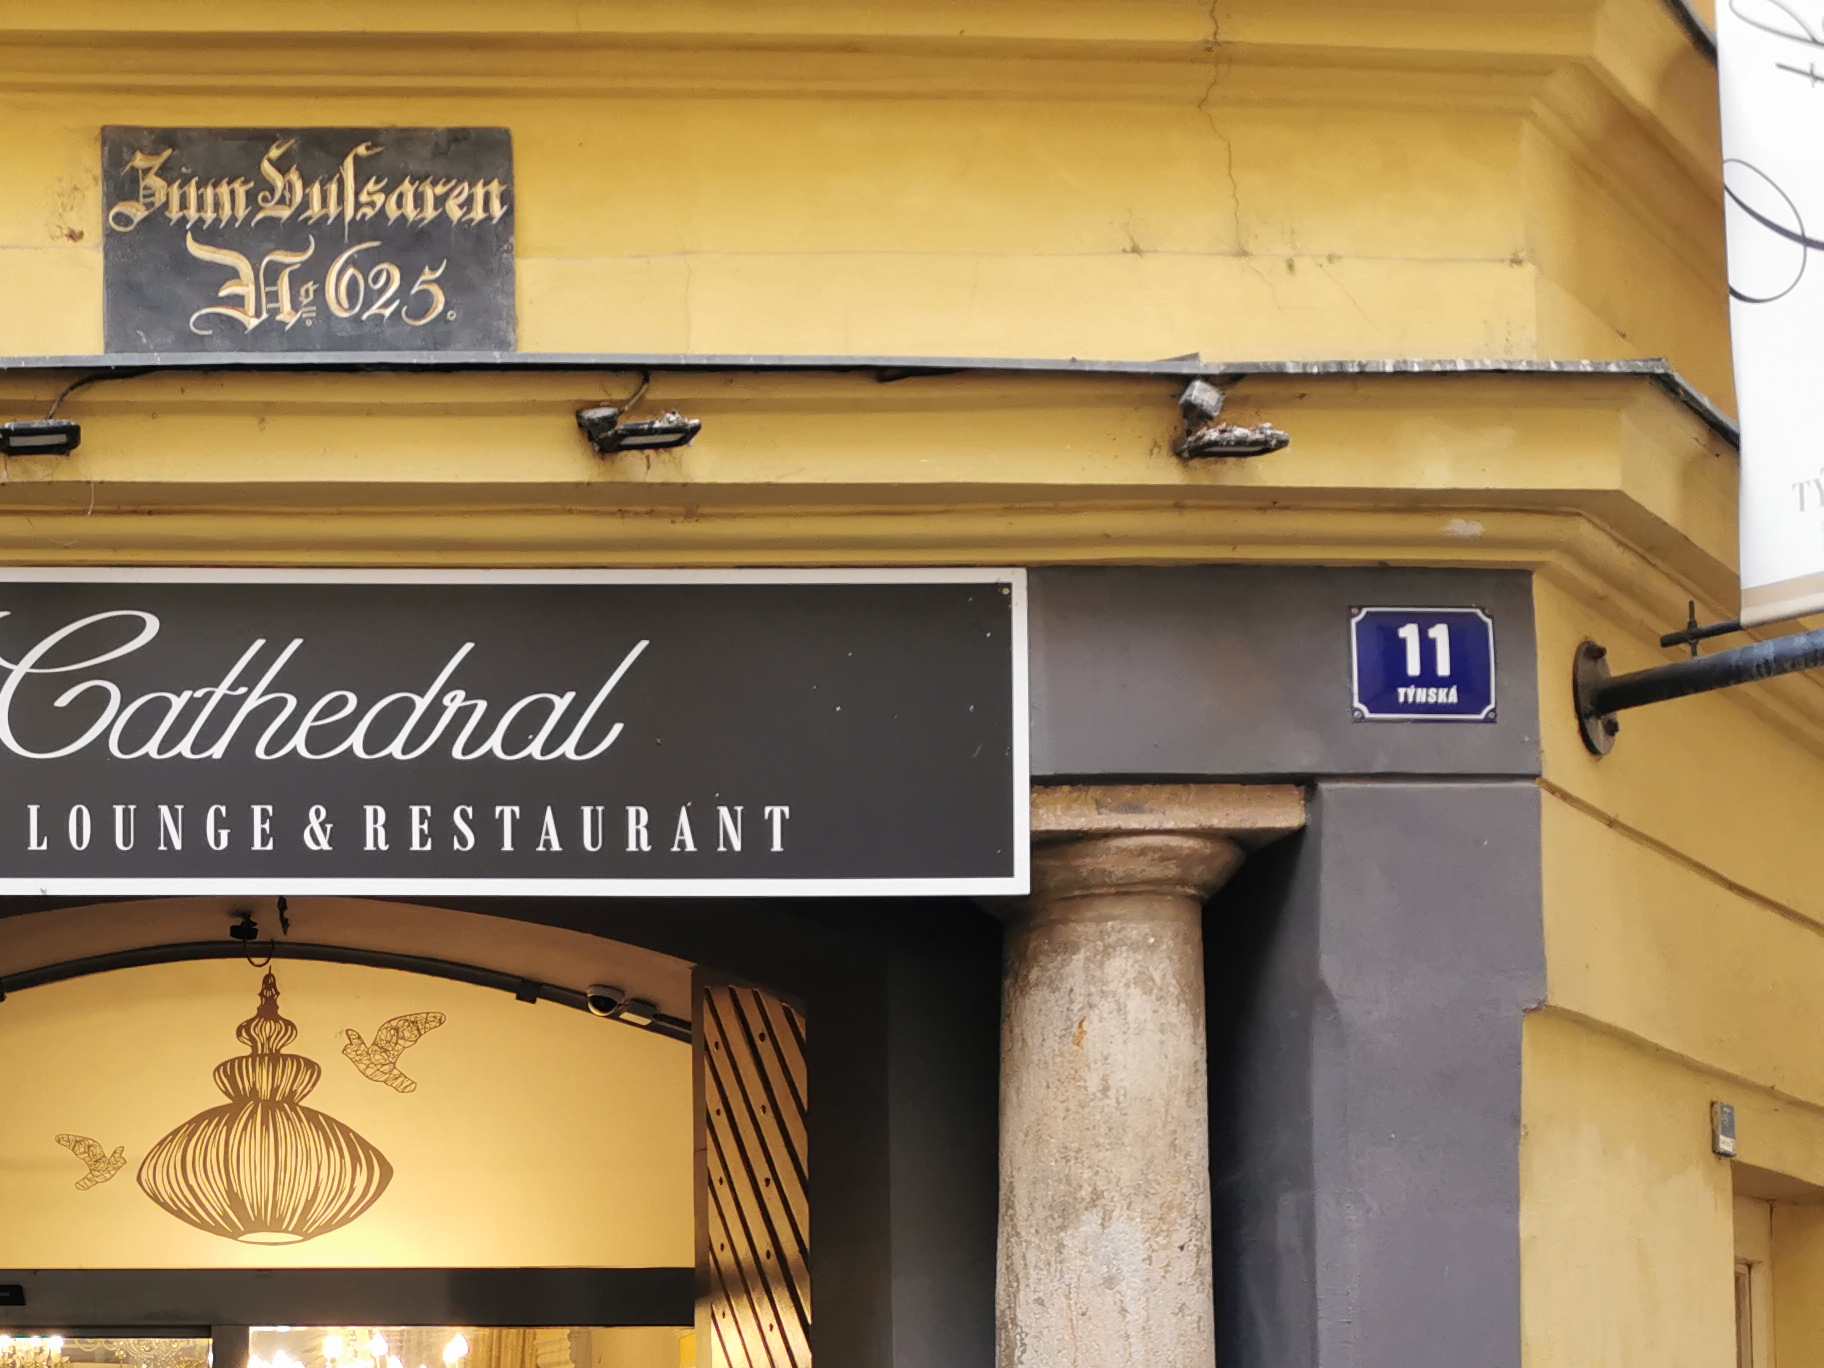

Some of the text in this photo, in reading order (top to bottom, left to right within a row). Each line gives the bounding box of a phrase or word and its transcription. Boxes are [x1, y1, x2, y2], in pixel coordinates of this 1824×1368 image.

[1397, 622, 1452, 678] 11
[1396, 684, 1459, 704] TÝNSKÁ
[26, 803, 275, 851] LOUNGE
[303, 803, 334, 852] &
[363, 804, 791, 852] RESTAURANT
